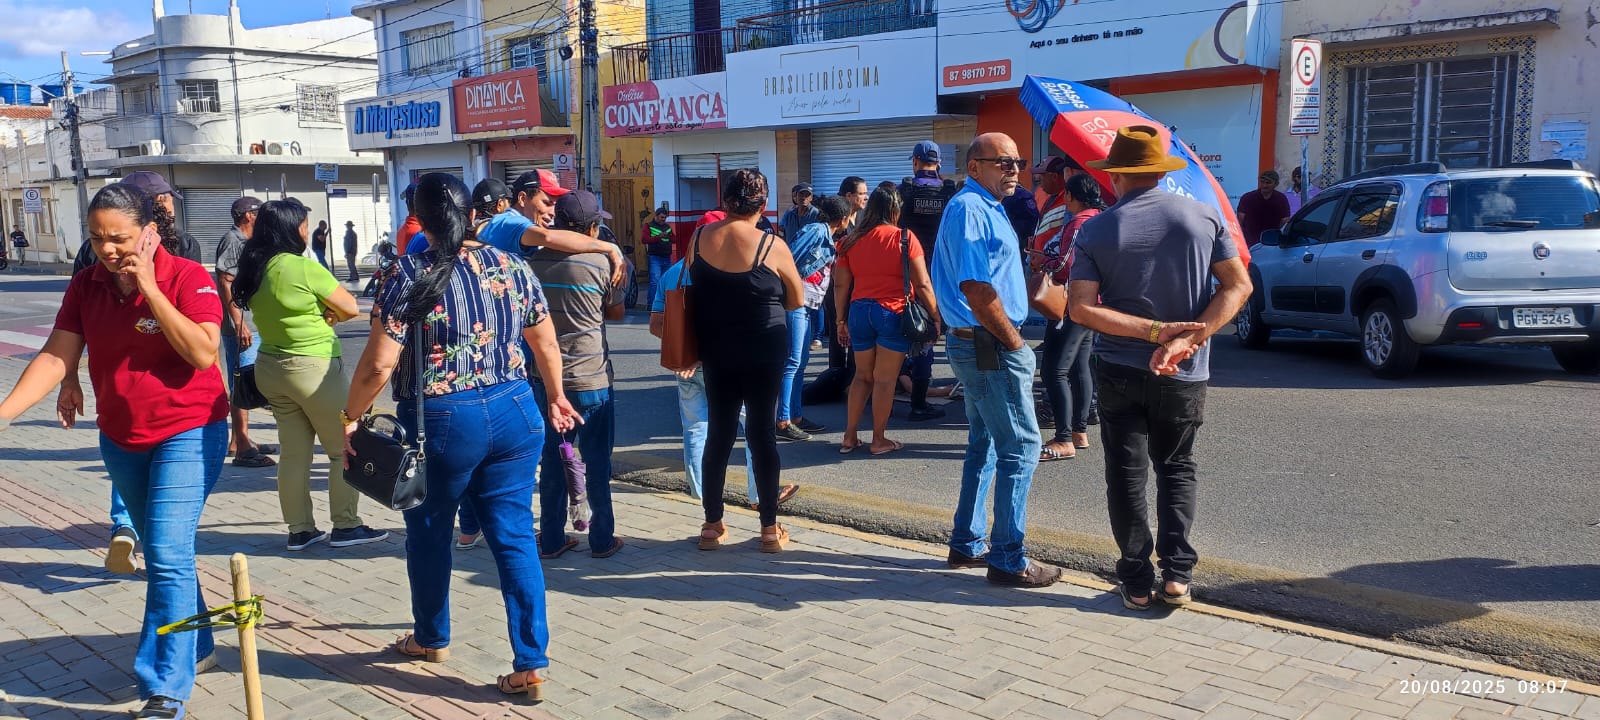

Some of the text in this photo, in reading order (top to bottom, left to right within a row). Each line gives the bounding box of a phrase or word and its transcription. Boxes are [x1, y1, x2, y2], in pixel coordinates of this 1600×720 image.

[1071, 34, 1099, 43] dinheiro
[1103, 30, 1110, 39] tá
[1126, 26, 1143, 37] mão
[949, 65, 1006, 81] 87 98170 7178
[1304, 56, 1311, 76] E
[764, 65, 879, 96] BRASILEIRÍSSIMA
[1057, 83, 1089, 109] CASAS
[355, 101, 441, 139] A Majestosa
[604, 92, 726, 128] CONFIANÇA
[915, 200, 942, 208] GUARDA
